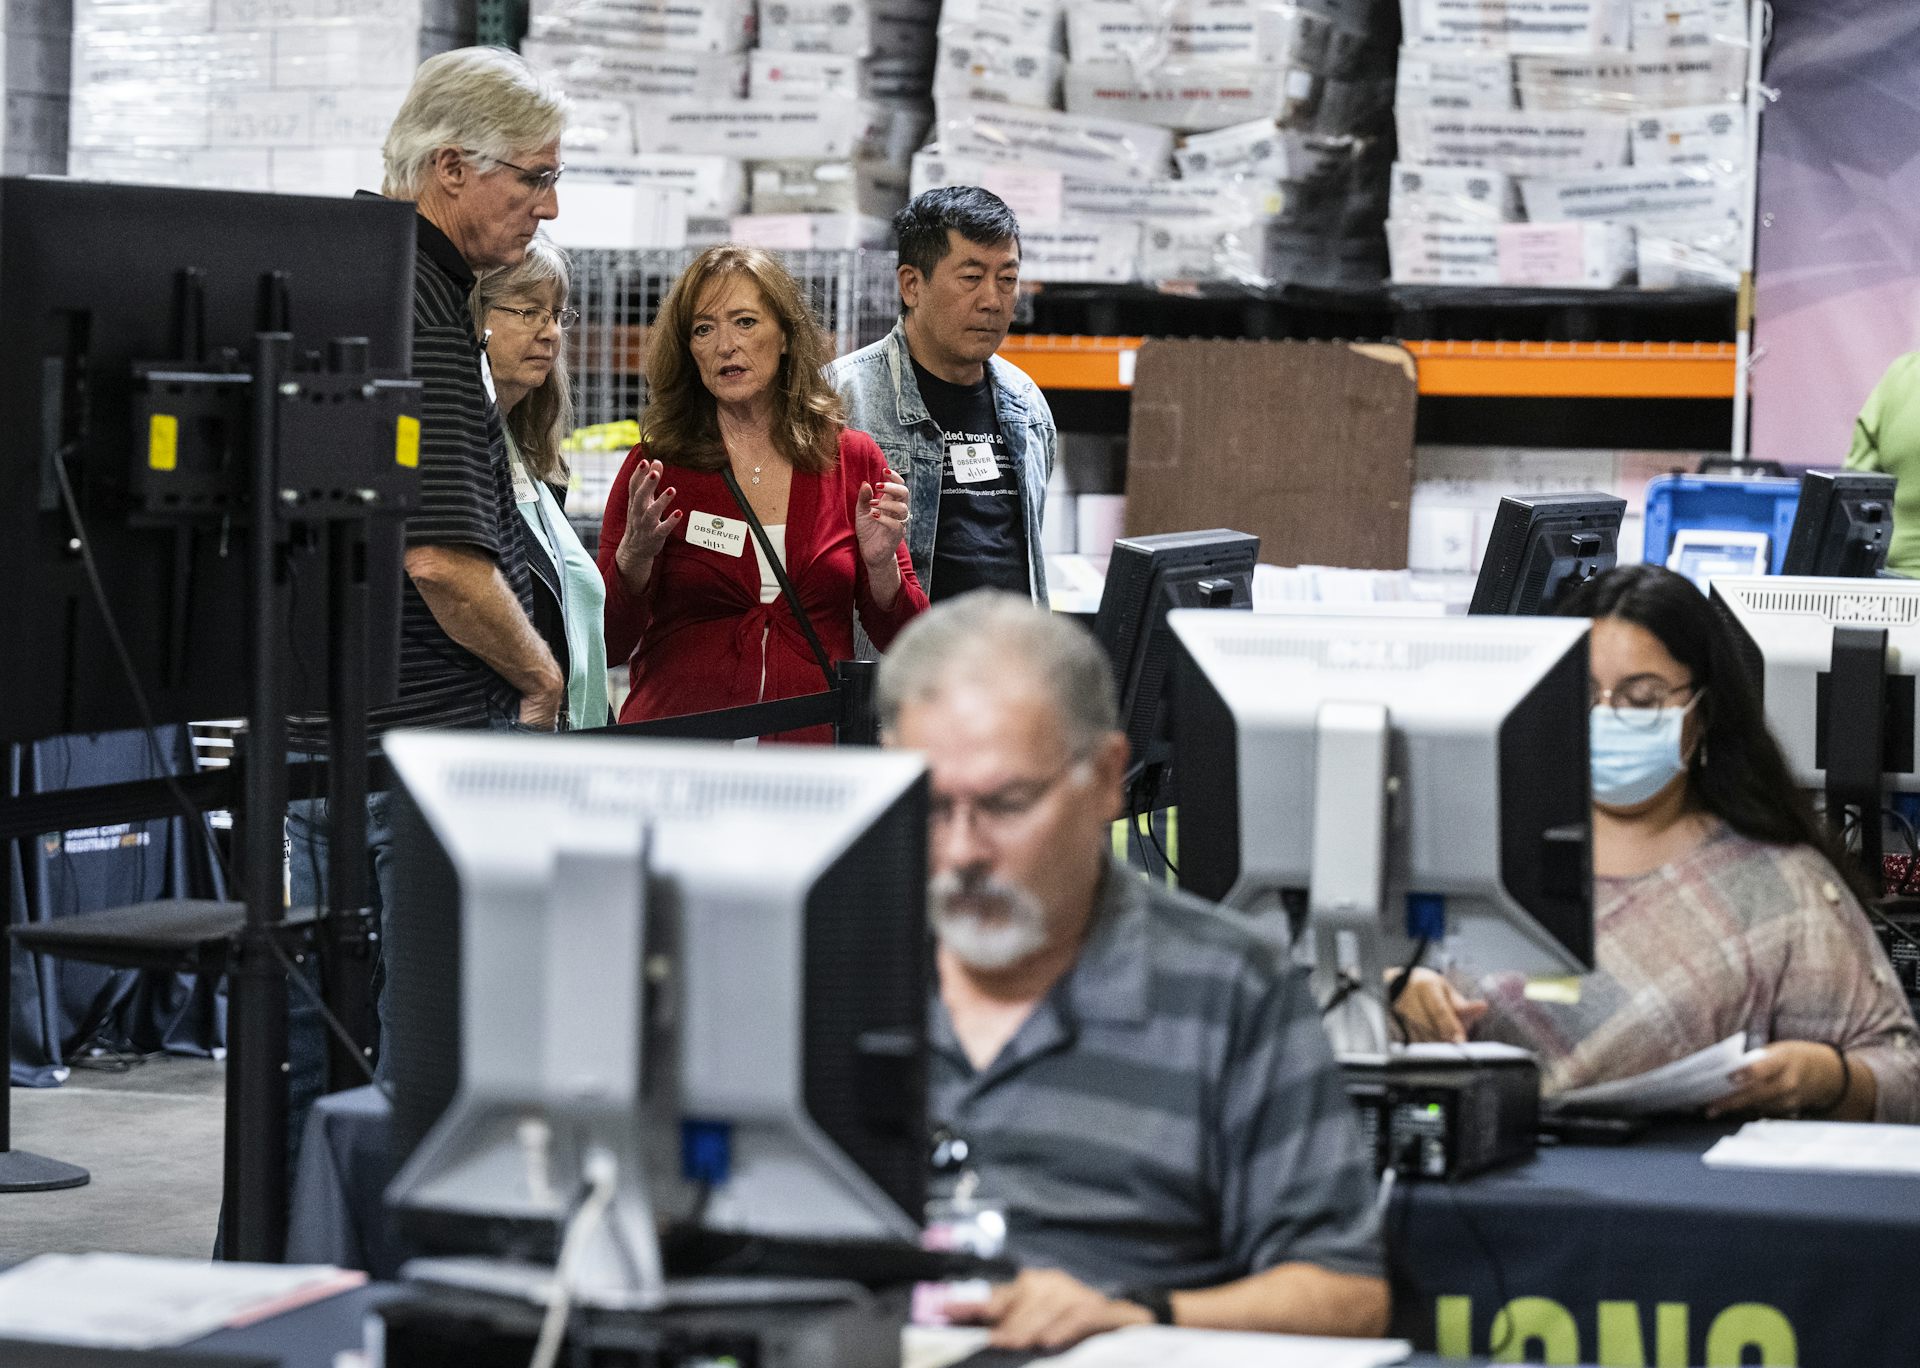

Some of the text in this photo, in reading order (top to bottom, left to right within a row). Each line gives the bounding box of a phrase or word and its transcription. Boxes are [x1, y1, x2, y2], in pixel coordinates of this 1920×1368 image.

[965, 432, 995, 444] world
[956, 456, 992, 466] OBSERVER
[694, 524, 740, 541] OBSERVER
